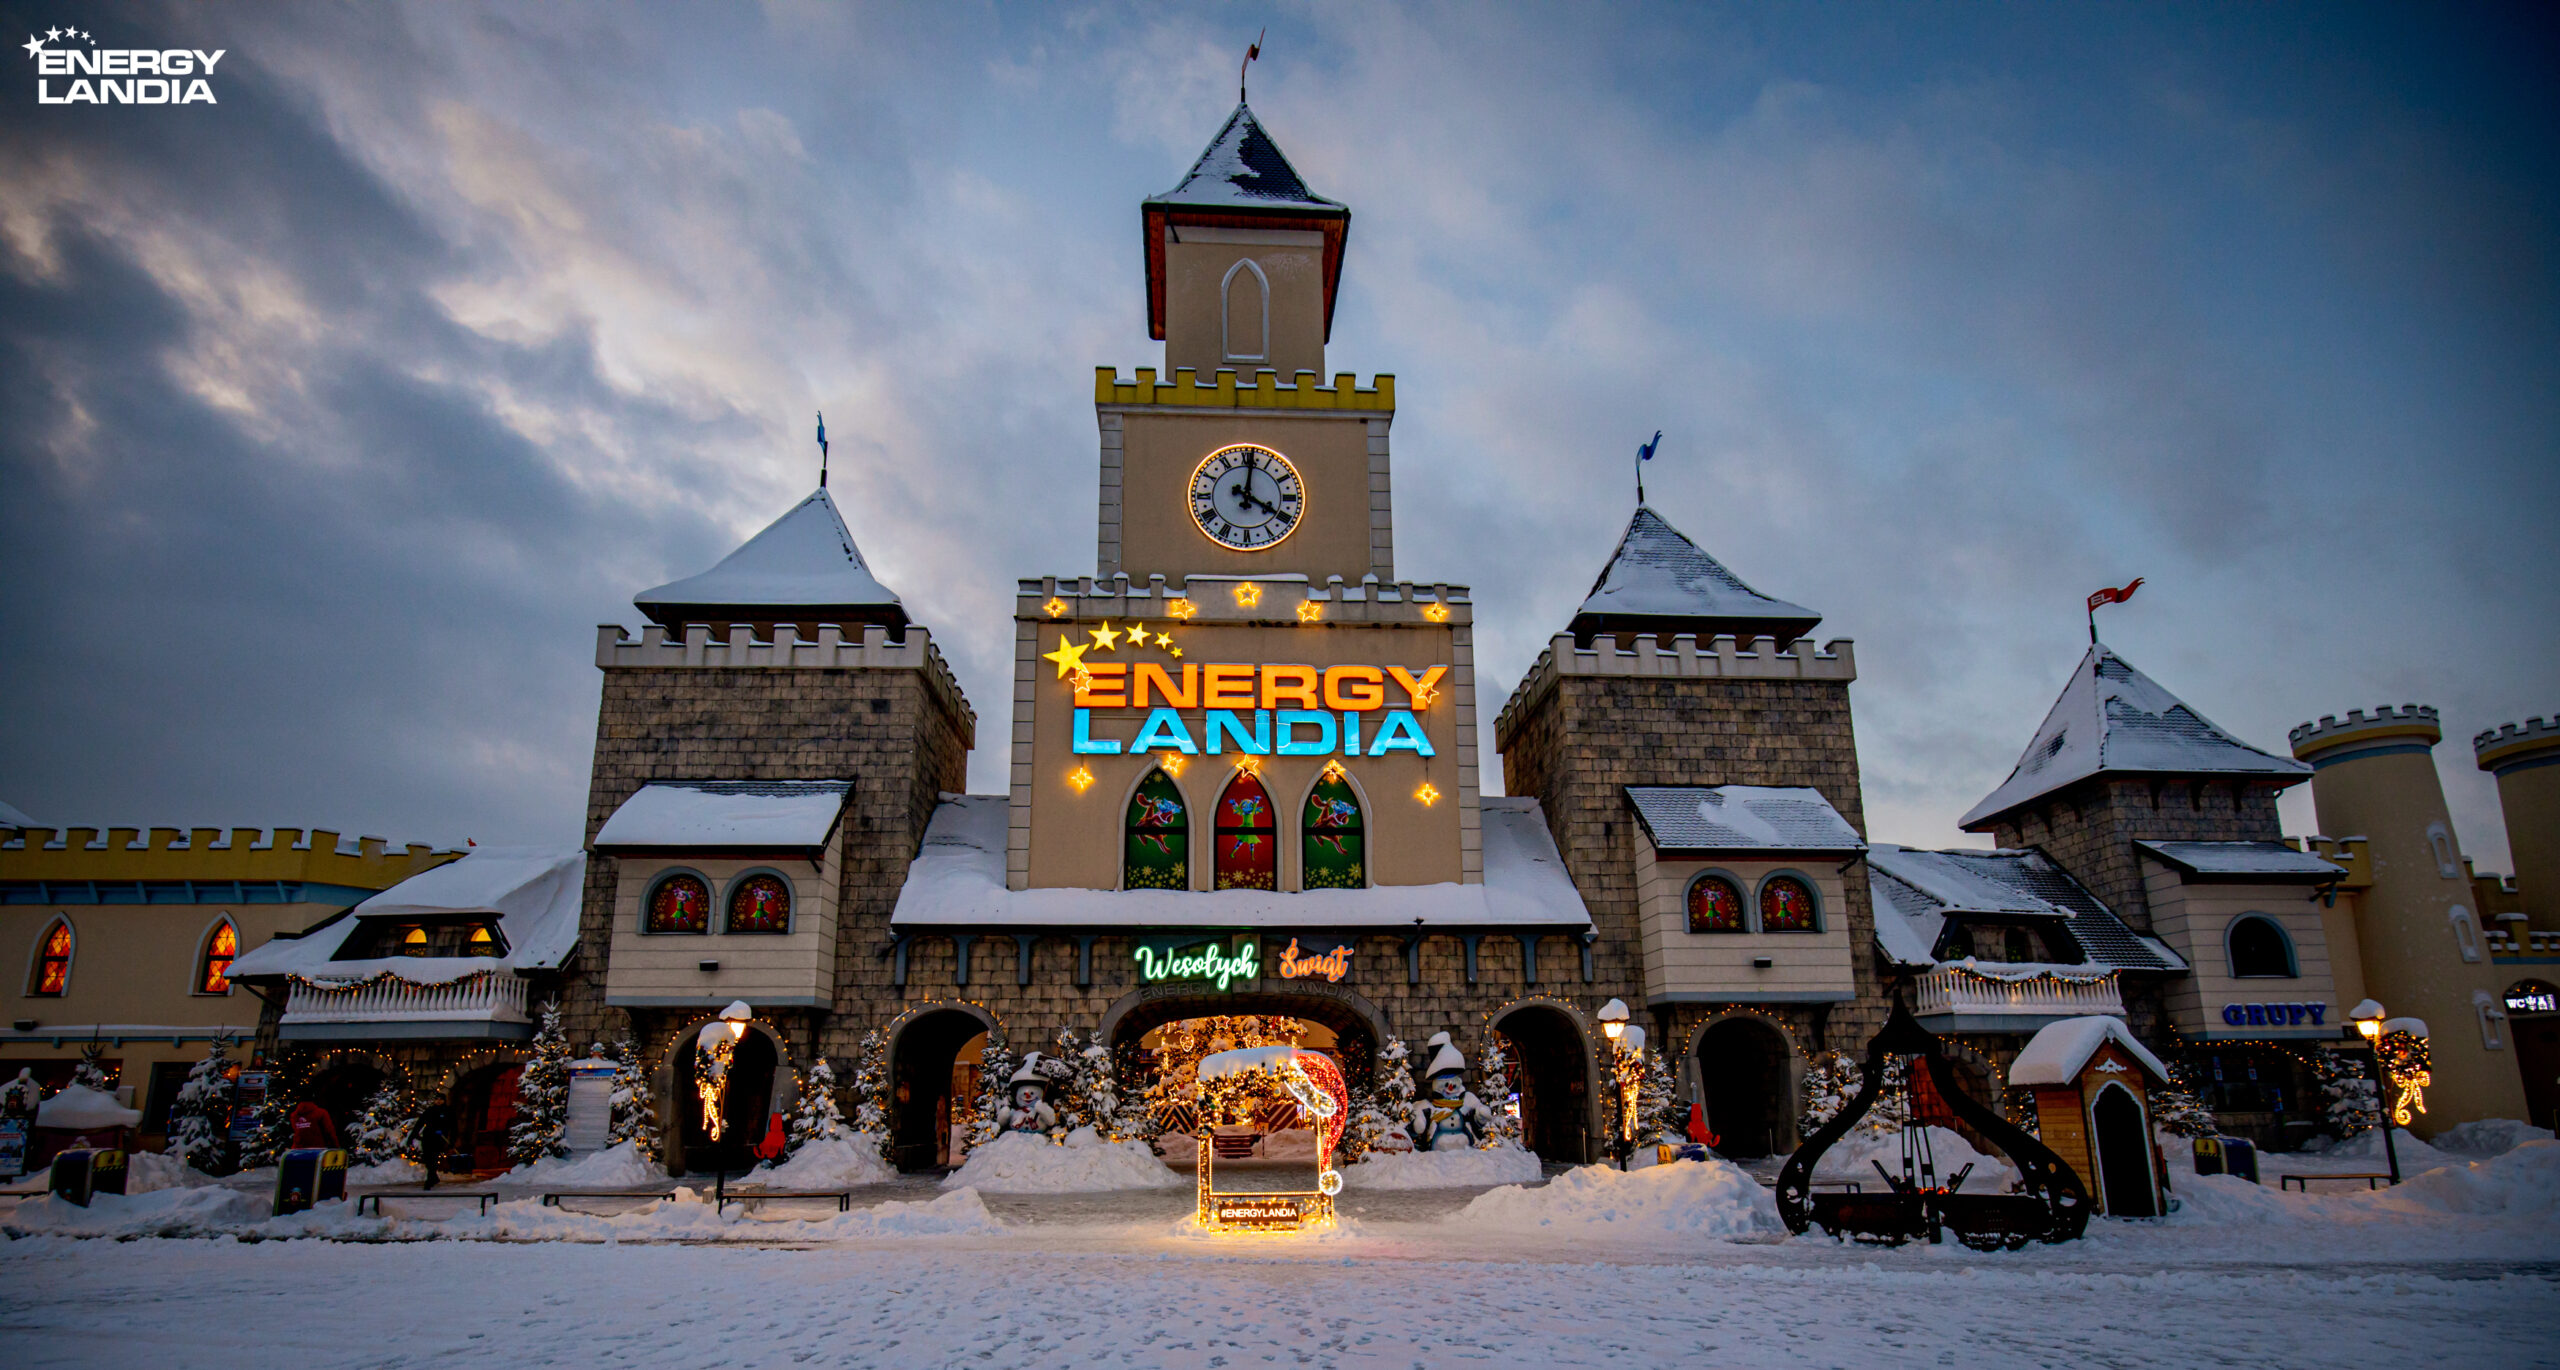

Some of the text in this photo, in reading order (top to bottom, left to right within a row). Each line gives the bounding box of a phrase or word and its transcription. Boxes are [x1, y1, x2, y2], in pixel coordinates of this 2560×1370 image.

[2090, 593, 2112, 607] EL
[1073, 662, 1448, 712] ENERGY
[1072, 707, 1437, 757] LANDIA
[1134, 938, 1354, 991] Wesołych Świąt
[1138, 981, 1356, 1004] ENERGY LANDIA
[2505, 998, 2526, 1009] WC
[2222, 1002, 2327, 1026] GRUPY
[1220, 1207, 1297, 1218] #ENERGYLANDIA
